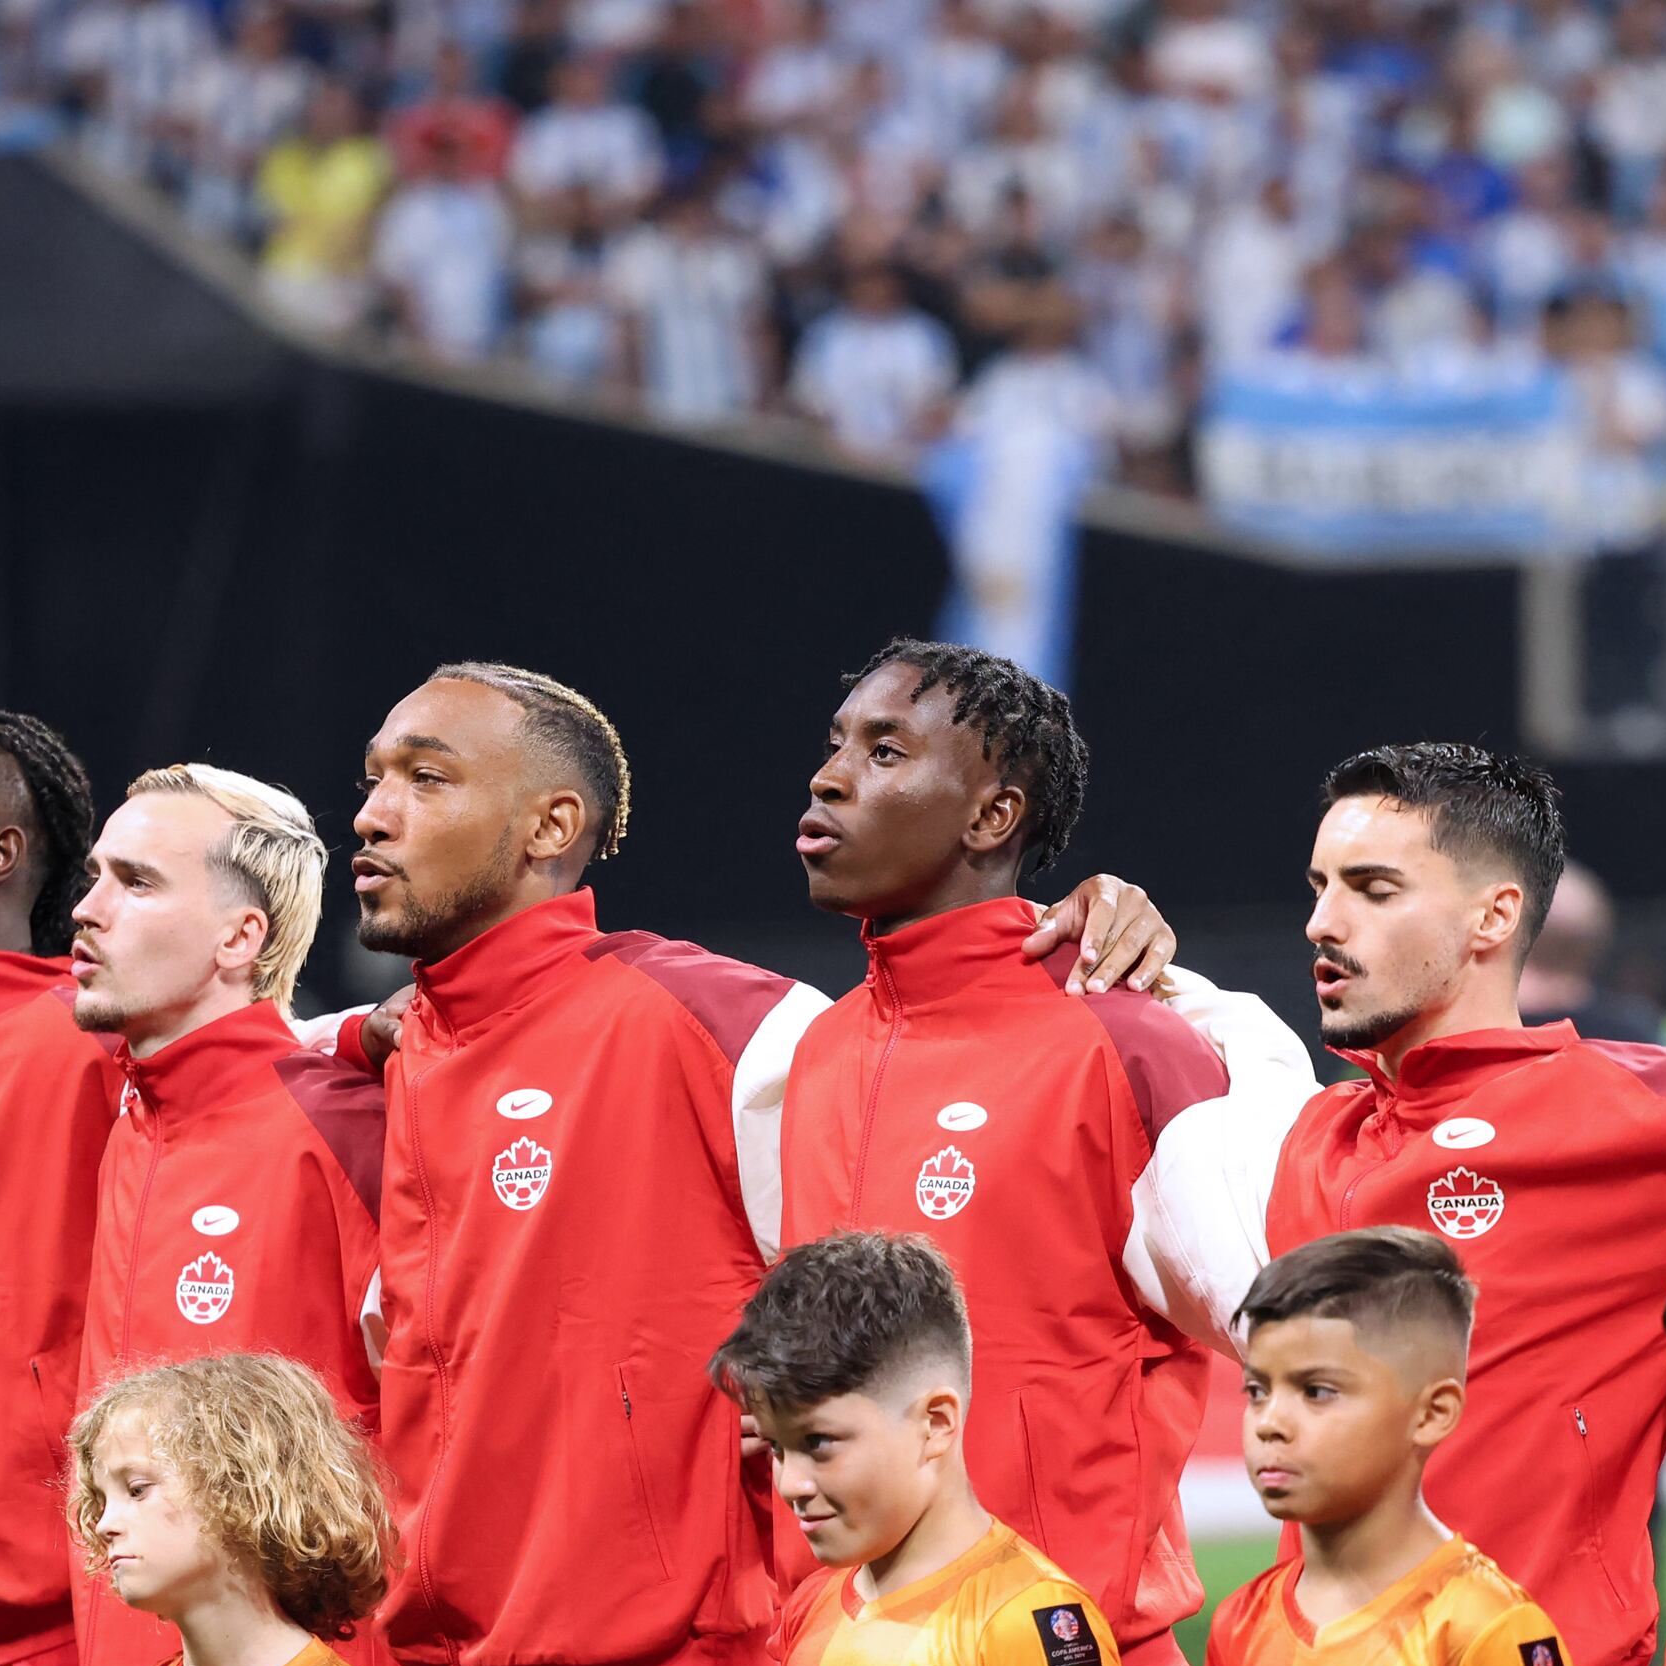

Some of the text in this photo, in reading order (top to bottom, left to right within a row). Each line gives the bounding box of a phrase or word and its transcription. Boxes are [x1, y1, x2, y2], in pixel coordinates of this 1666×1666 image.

[495, 1169, 548, 1182] CANADA
[919, 1179, 970, 1191] CANADA
[1431, 1197, 1500, 1209] CANADA
[180, 1284, 229, 1295] CANADA
[1051, 1650, 1068, 1658] COPA
[1068, 1644, 1093, 1655] AMERICA
